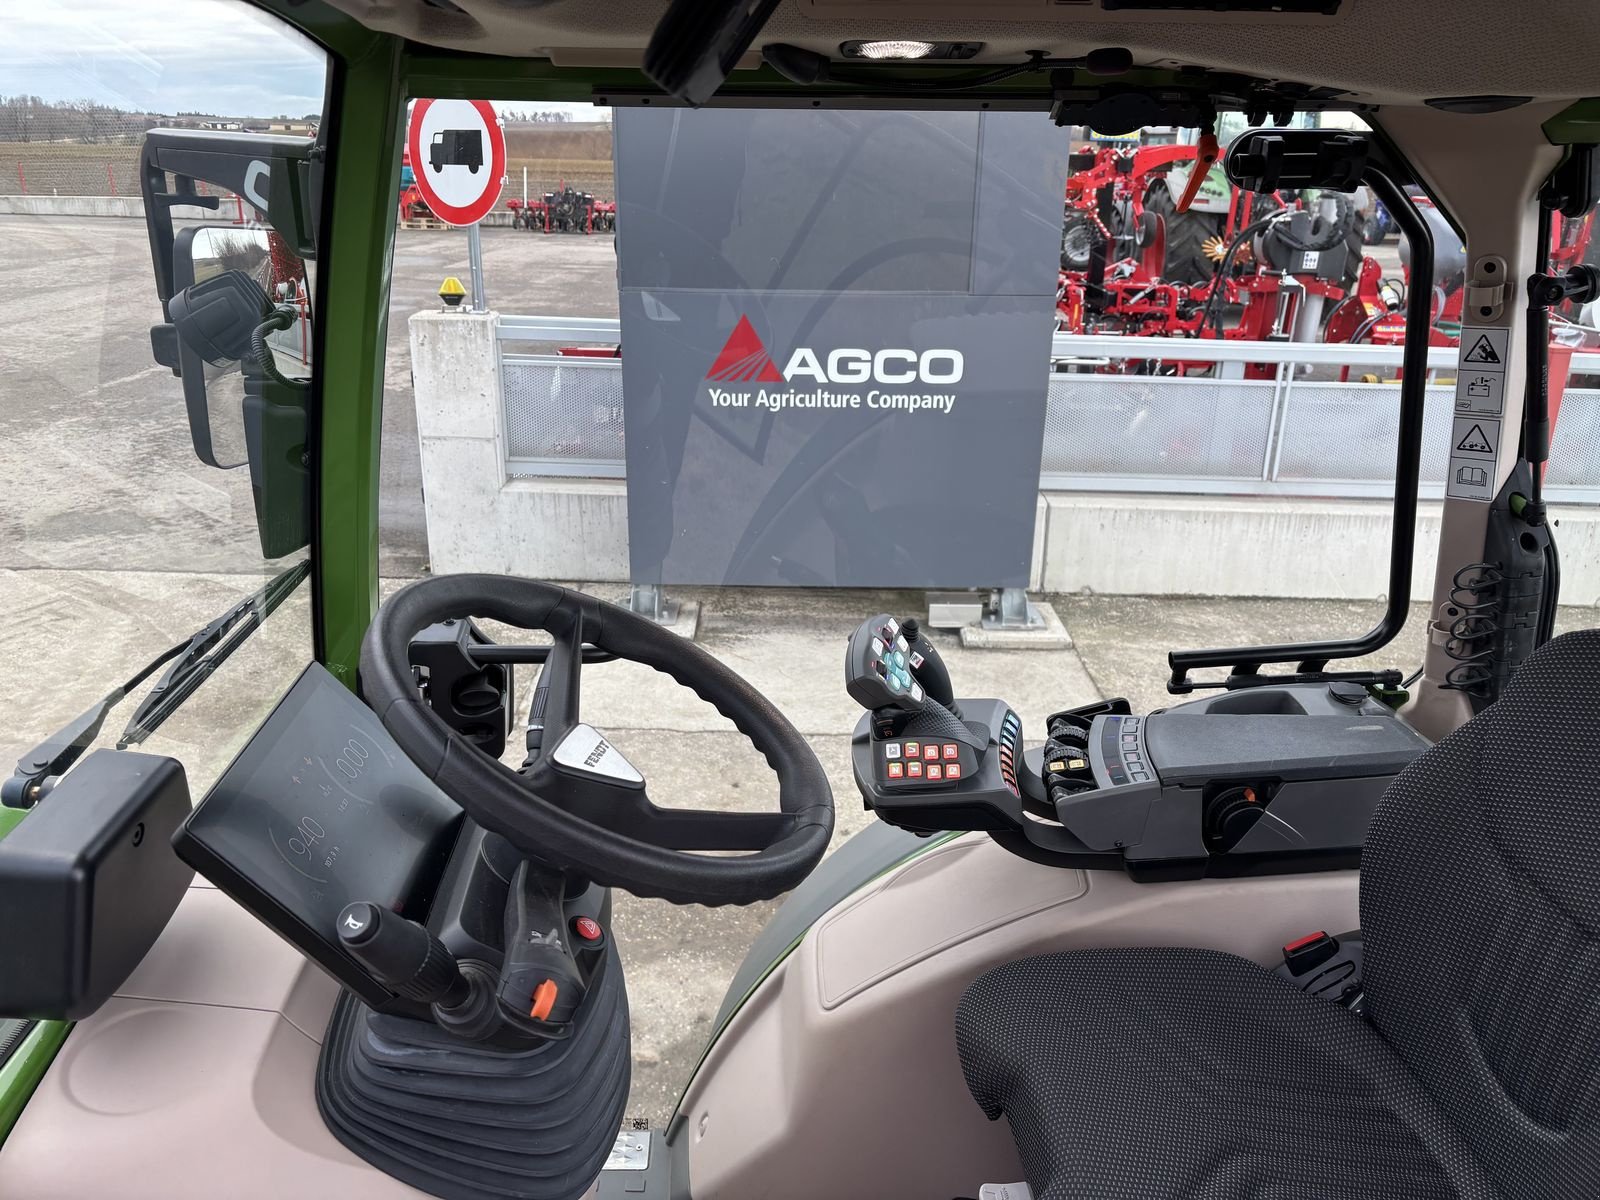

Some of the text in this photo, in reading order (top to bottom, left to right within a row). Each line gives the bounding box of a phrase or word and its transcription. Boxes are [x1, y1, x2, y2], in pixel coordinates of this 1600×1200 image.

[783, 348, 964, 384] AGCO
[708, 388, 956, 413] Your Agriculture Company
[584, 740, 610, 767] FENDT
[288, 816, 325, 861] 940
